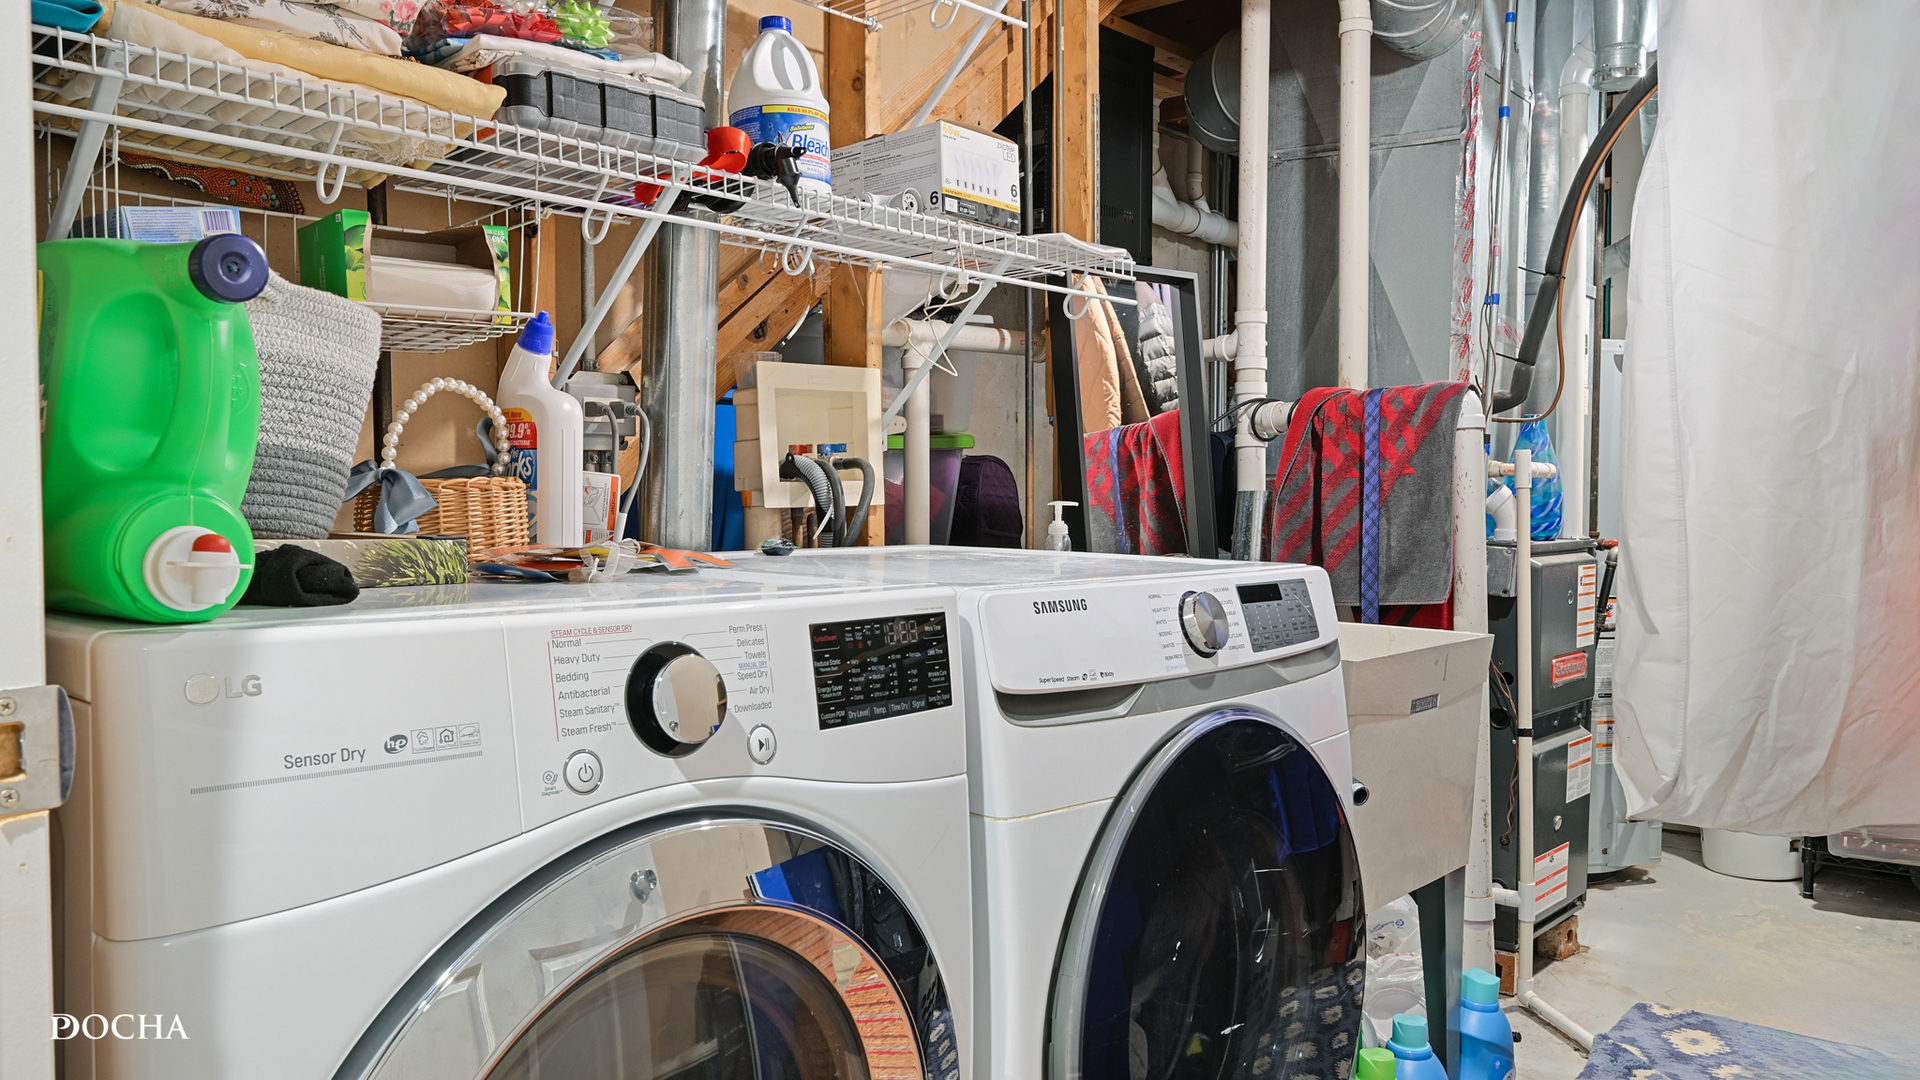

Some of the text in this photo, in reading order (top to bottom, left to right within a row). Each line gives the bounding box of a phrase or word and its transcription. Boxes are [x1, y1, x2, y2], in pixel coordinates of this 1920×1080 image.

[942, 124, 960, 137] 65W
[792, 134, 829, 158] Bleach
[1003, 151, 1016, 163] LED
[1010, 184, 1018, 198] 6
[930, 191, 939, 205] 6
[1033, 598, 1088, 614] SAMSUNG
[551, 629, 572, 637] STEAM
[573, 628, 593, 636] CYCLE
[598, 626, 620, 634] SENSOR
[621, 624, 633, 632] DRY
[552, 639, 582, 649] Normal
[737, 638, 765, 648] Delicates
[553, 652, 600, 667] Heavy Duty
[744, 651, 766, 660] Towels
[738, 660, 768, 669] MANUAL DRY
[1555, 661, 1585, 676] Goodman
[555, 672, 589, 683] Bedding
[737, 669, 768, 681] Speed Dry
[224, 674, 263, 699] LG
[749, 685, 770, 696] Air Dry
[817, 684, 843, 694] Energy Saver
[558, 686, 611, 700] Antibacterial
[734, 700, 772, 713] Downloaded
[891, 701, 908, 711] Time Dry
[912, 698, 925, 708] Signal
[559, 708, 584, 718] Steam
[848, 708, 868, 719] Dry Level
[873, 705, 887, 715] Temp.
[820, 712, 835, 720] Custom
[561, 727, 588, 737] Steam
[284, 748, 366, 769] Sensor Dry
